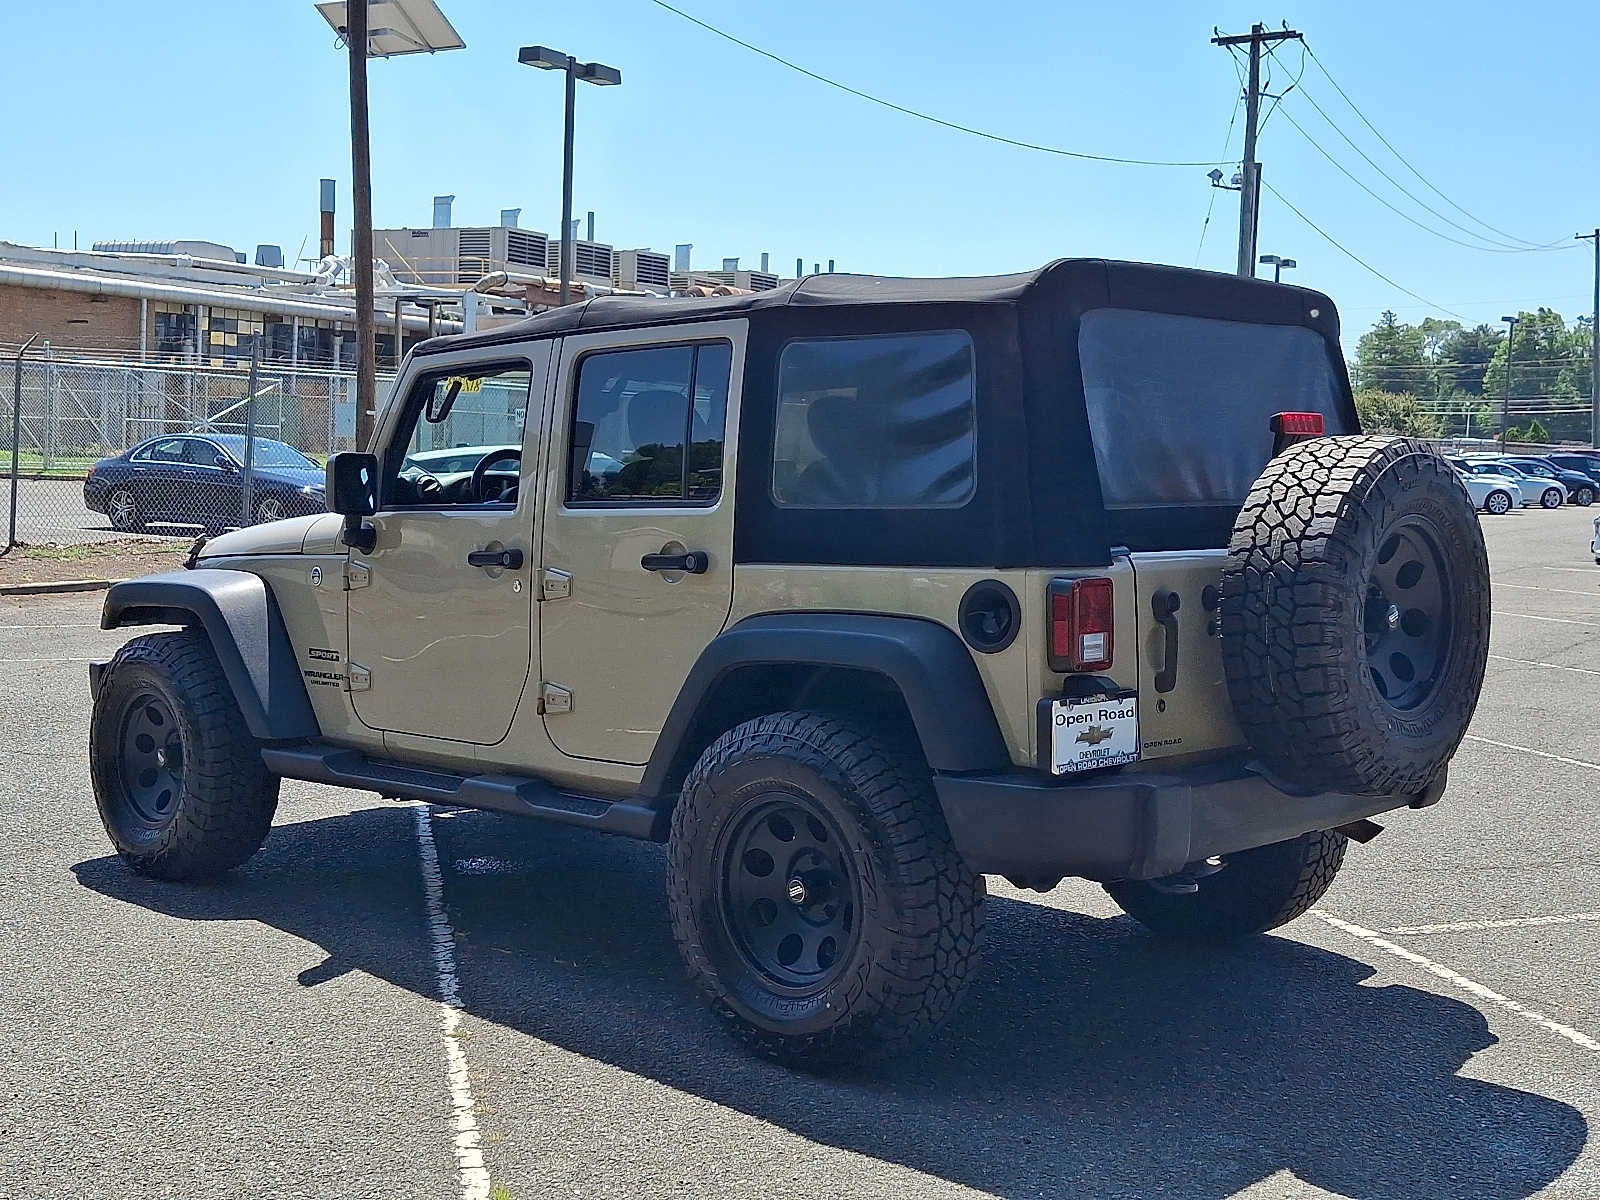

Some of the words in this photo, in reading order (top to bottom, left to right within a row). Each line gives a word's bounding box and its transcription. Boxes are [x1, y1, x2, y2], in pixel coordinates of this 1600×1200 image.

[310, 650, 338, 659] SPORT
[304, 670, 344, 681] WRANGLER
[1055, 714, 1093, 728] Open
[1098, 706, 1135, 721] Road
[1143, 741, 1162, 749] OPEN
[1163, 737, 1183, 745] ROAD
[1079, 747, 1110, 760] CHEVROLET
[1059, 763, 1077, 775] OPEN
[1077, 759, 1098, 772] ROAD
[1098, 753, 1138, 768] CHEVROLET
